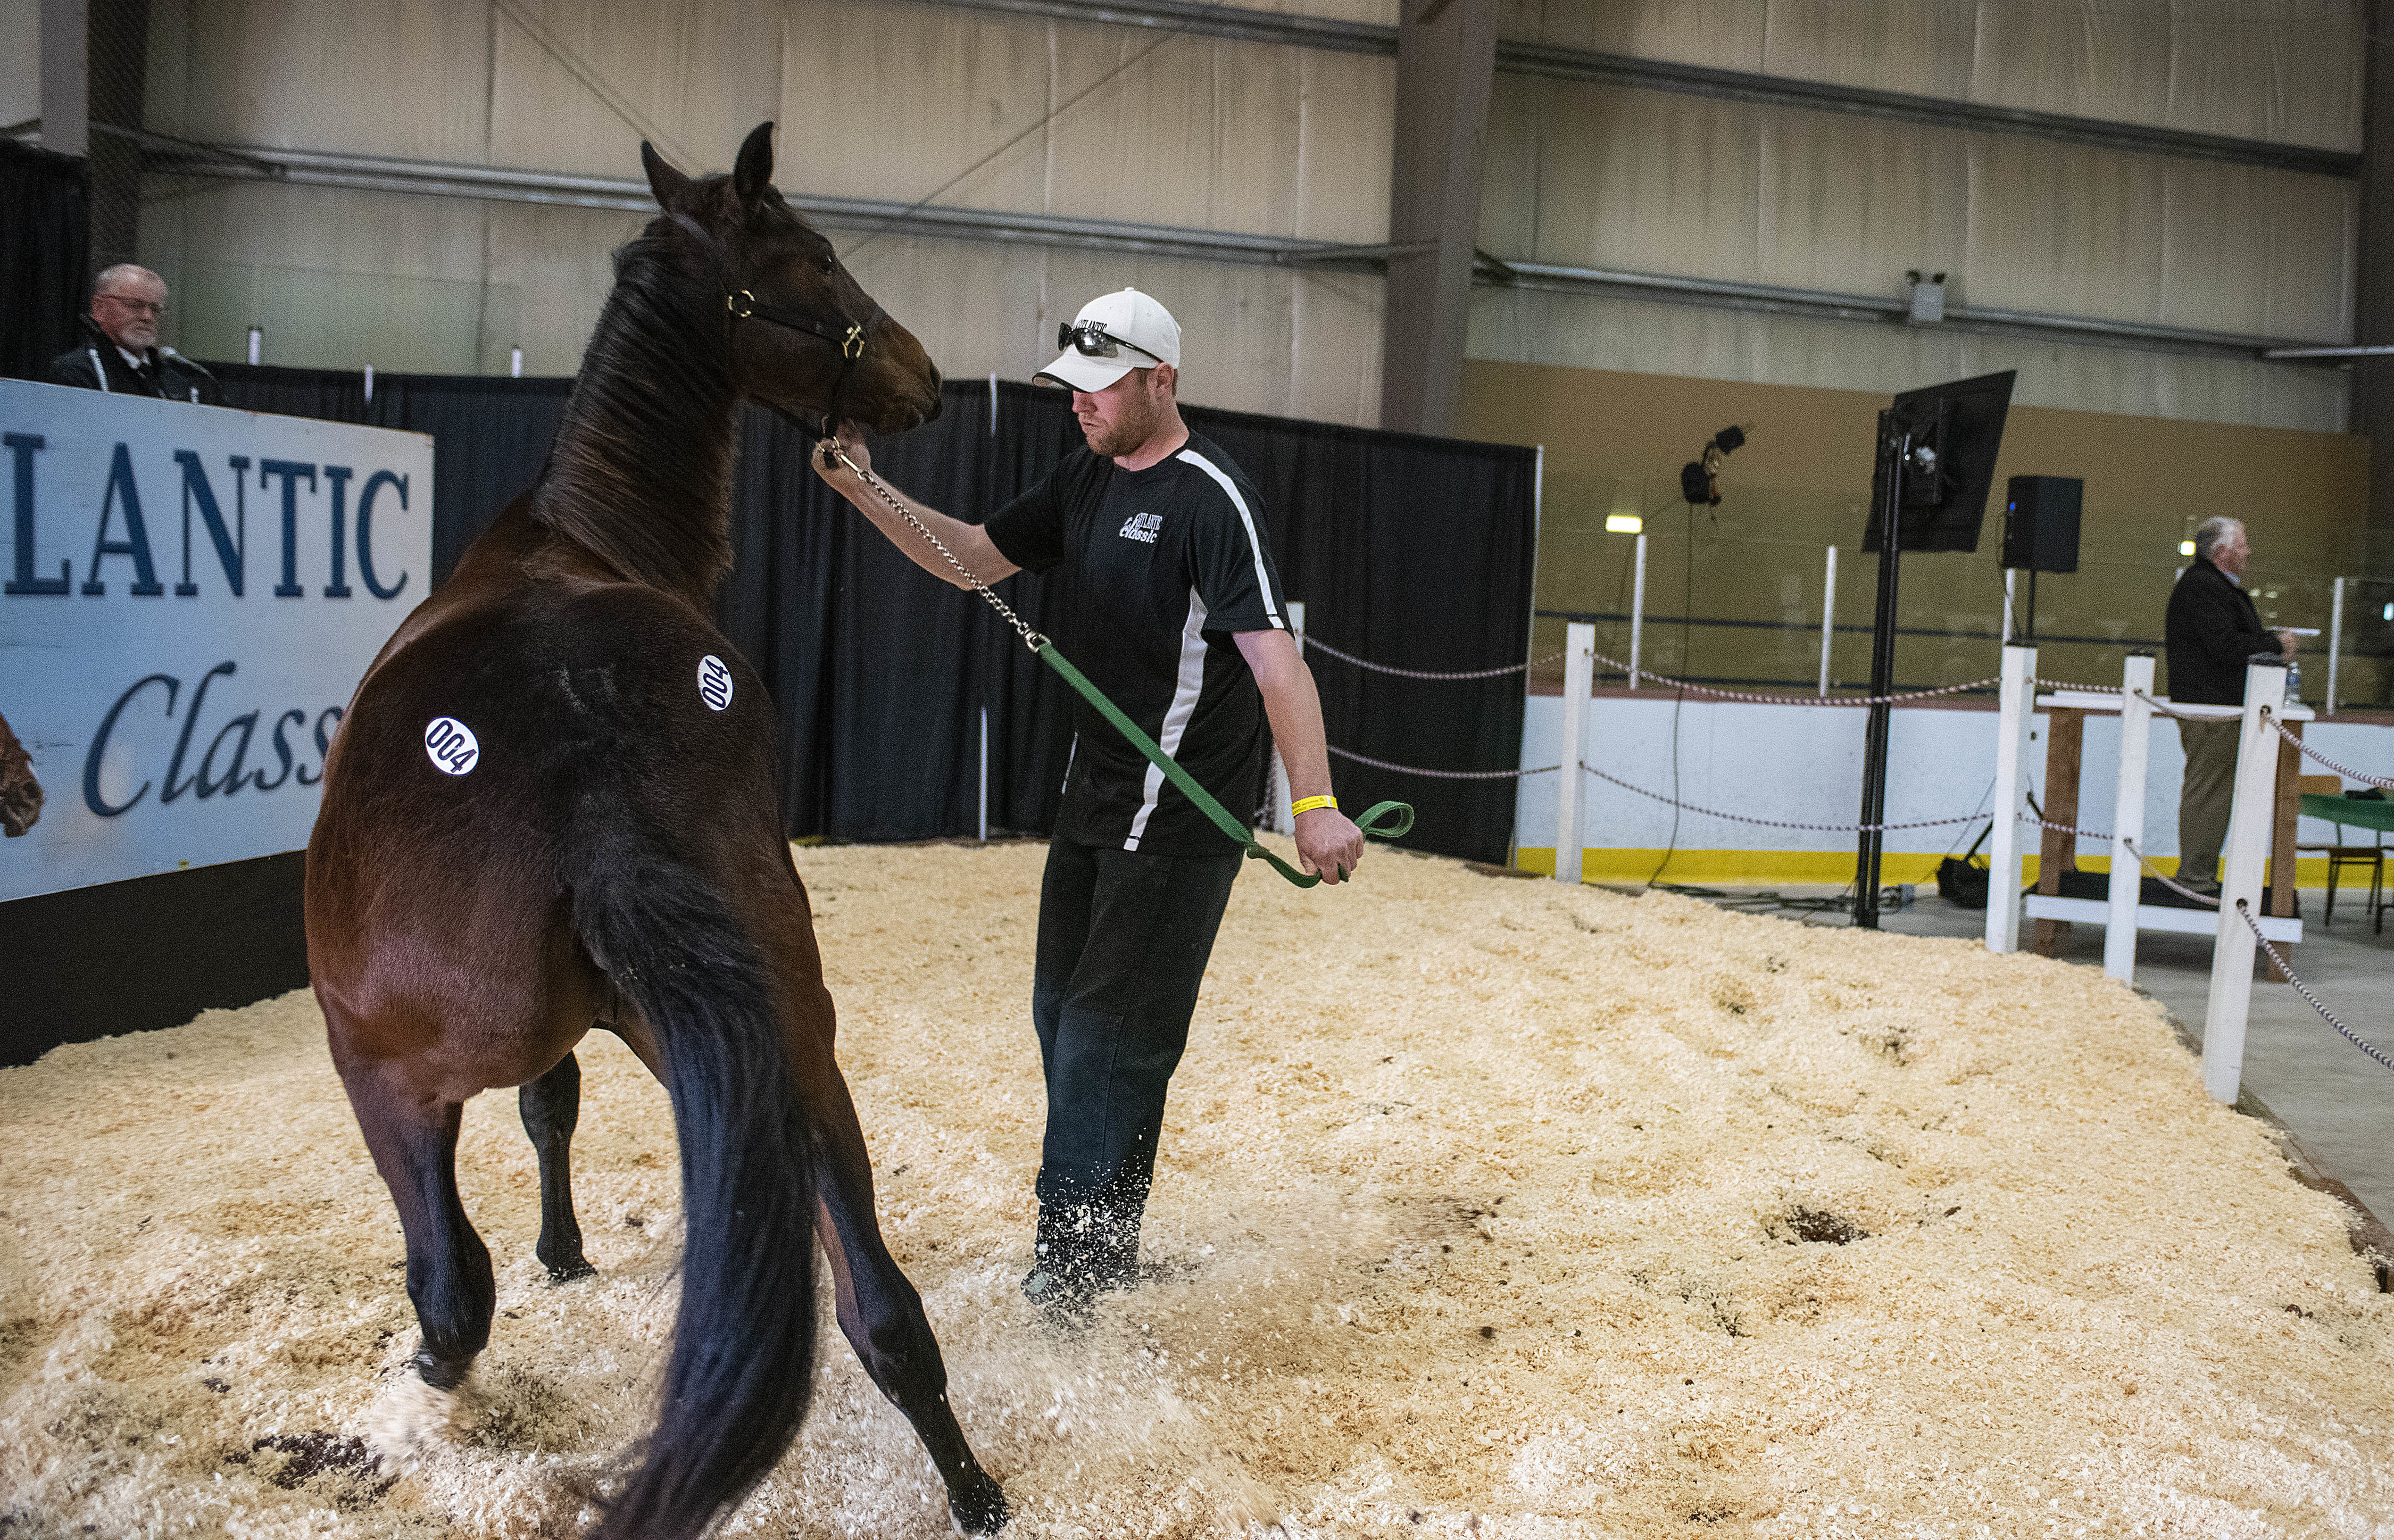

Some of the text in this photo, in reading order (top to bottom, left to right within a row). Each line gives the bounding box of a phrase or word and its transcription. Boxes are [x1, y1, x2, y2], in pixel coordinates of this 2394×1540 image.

[702, 658, 728, 709] 004
[82, 661, 343, 817] Class
[426, 720, 477, 773] 004
